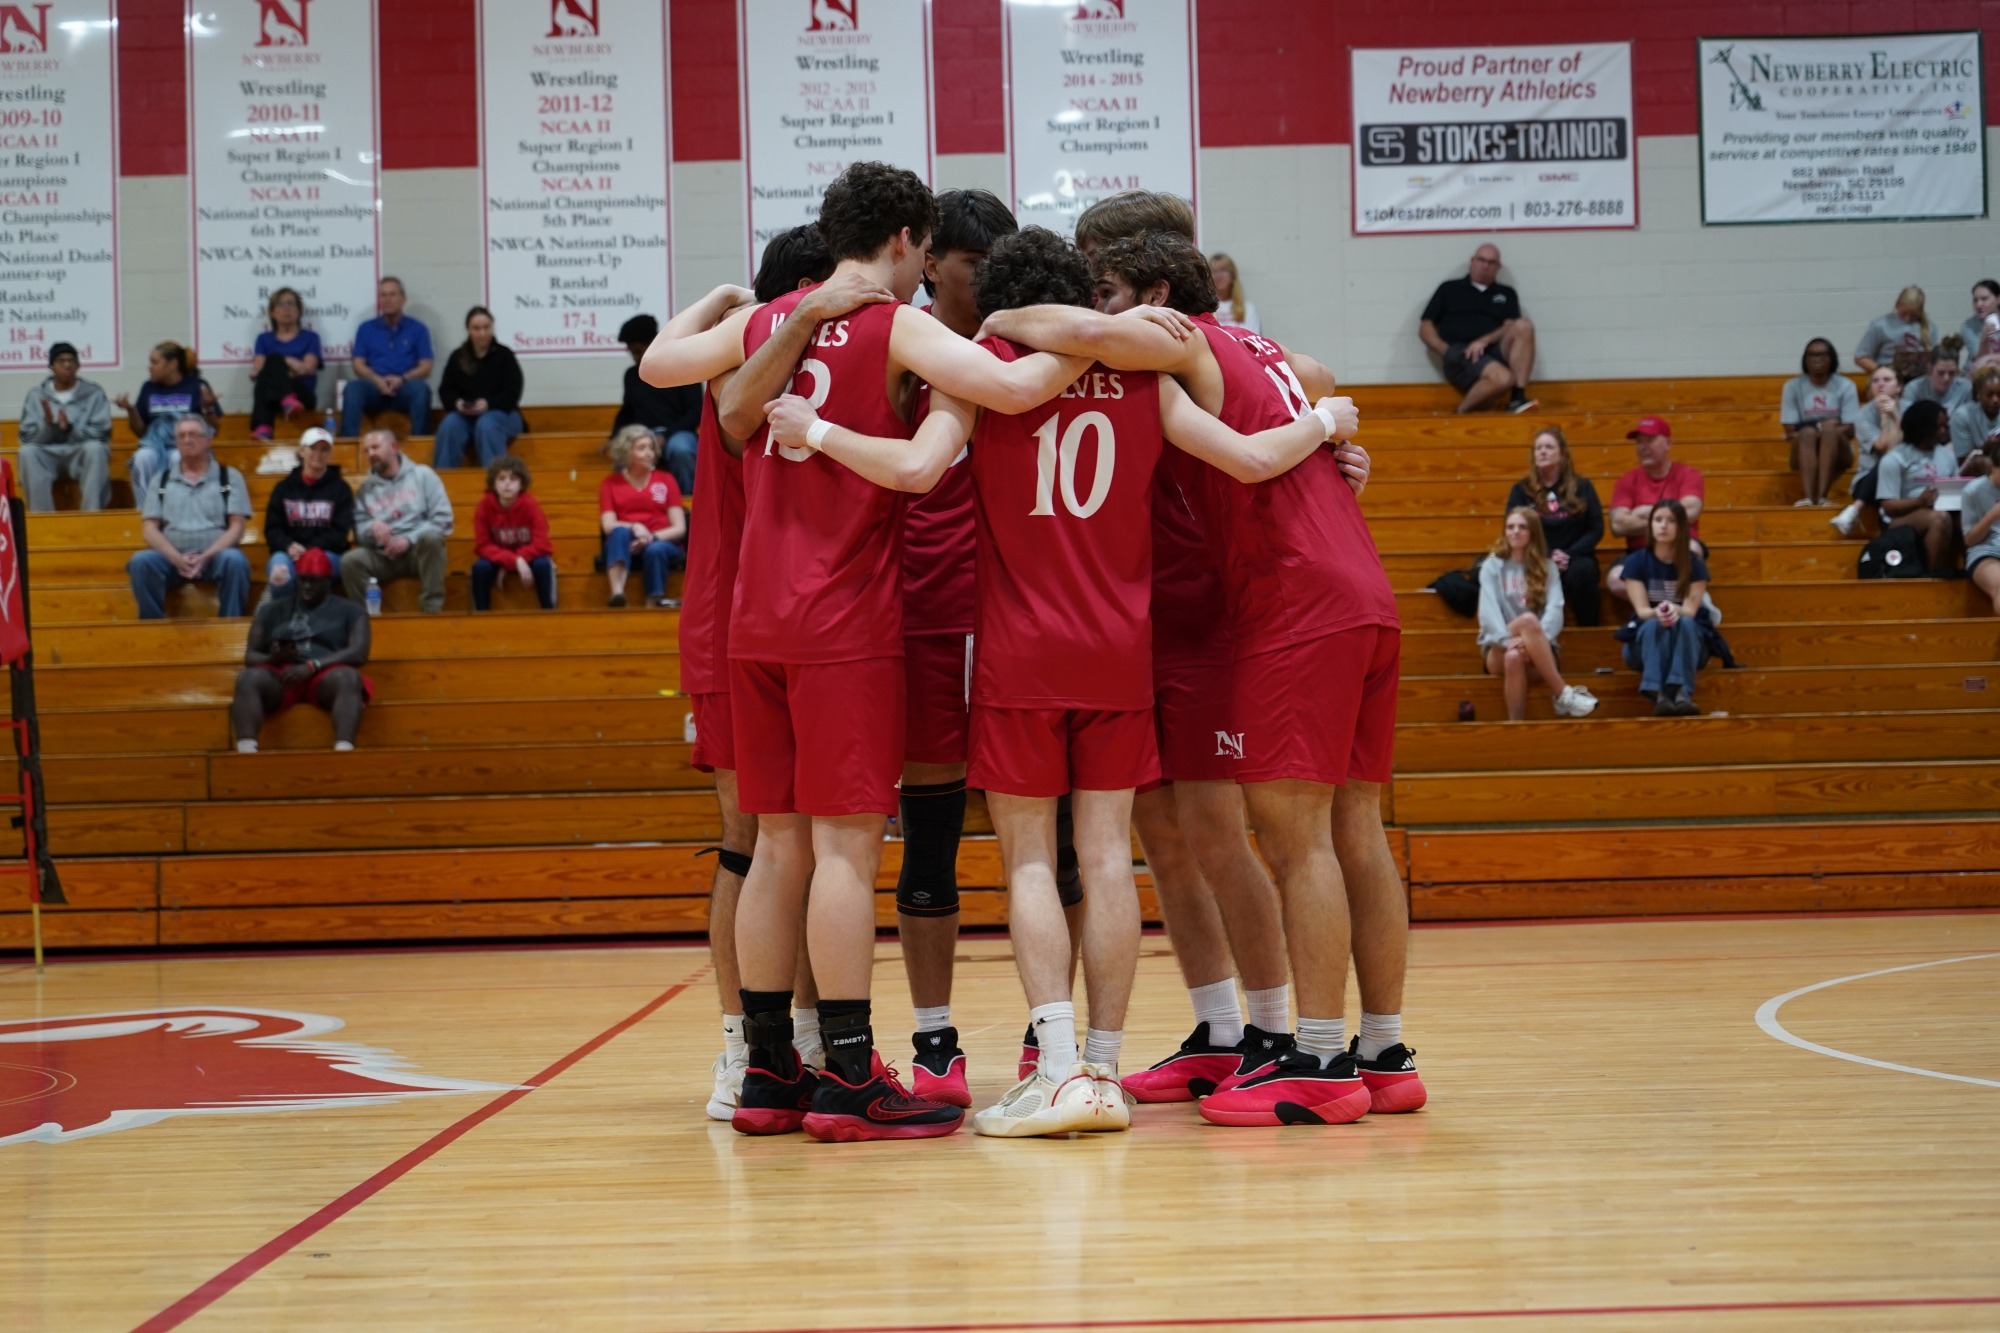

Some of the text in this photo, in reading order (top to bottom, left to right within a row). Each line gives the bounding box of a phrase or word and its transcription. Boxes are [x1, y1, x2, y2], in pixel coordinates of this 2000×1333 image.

[796, 54, 880, 71] Wrestling
[1060, 49, 1145, 67] Wrestling
[1397, 51, 1584, 77] Proud Partner of
[1750, 51, 1974, 84] NEWBERRY ELECTRIC
[530, 69, 619, 89] Wrestling
[800, 81, 831, 96] 2012
[845, 79, 877, 95] 2013
[1063, 74, 1096, 88] 2014
[1111, 72, 1143, 87] 2015
[0, 85, 65, 103] restling
[239, 79, 327, 98] Wrestling
[1388, 78, 1598, 107] Newberry Athletics
[246, 103, 320, 122] 2010-11
[538, 94, 613, 114] 2011-12
[806, 97, 855, 111] NCAA
[1070, 97, 1120, 111] NCAA
[0, 108, 62, 127] 009-10
[781, 115, 825, 131] Super
[830, 112, 884, 128] Region
[1047, 117, 1091, 134] Super
[1096, 115, 1150, 132] Region
[540, 120, 592, 134] NCAA
[1723, 124, 1969, 146] Providing our members with quality
[0, 134, 39, 148] CAA
[518, 140, 562, 156] Super
[567, 138, 622, 154] Region
[794, 134, 883, 149] Champions
[1060, 138, 1149, 155] Champions
[1417, 120, 1619, 163] STOKES-TRAINOR
[227, 149, 271, 165] Super
[276, 149, 330, 165] Region
[1709, 140, 1977, 162] service at competitive rates since 1940
[15, 152, 69, 169] Region
[532, 159, 621, 175] Champions
[807, 161, 846, 175] NCA
[0, 174, 67, 189] ampions
[241, 168, 329, 184] Champions
[541, 177, 593, 191] NCAA
[1072, 176, 1123, 190] NCAA
[0, 191, 40, 205] CAA
[250, 187, 302, 200] NCAA
[753, 184, 814, 199] National
[490, 193, 667, 211] National Championships
[3, 208, 113, 227] Championships
[199, 203, 374, 222] National Championships
[1364, 205, 1502, 223] stokestrainor.com
[1523, 199, 1624, 218] 803-276-8888
[572, 213, 612, 227] Place
[19, 229, 59, 243] Place
[251, 223, 321, 237] 6th Place
[491, 234, 667, 251] NWCA National Duals
[0, 249, 113, 264] National Duals
[199, 243, 374, 262] NWCA National Duals
[536, 253, 622, 269] Runner-Up
[0, 268, 66, 284] unner-up
[252, 263, 321, 277] 4th Place
[549, 275, 609, 289] Ranked
[258, 285, 316, 299] Red
[516, 293, 643, 309] No. 2 Nationally
[10, 307, 89, 325] Nationally
[223, 304, 253, 319] No.
[562, 311, 597, 328] 17-1
[514, 331, 617, 347] Season Rec
[1028, 410, 1116, 519] 10
